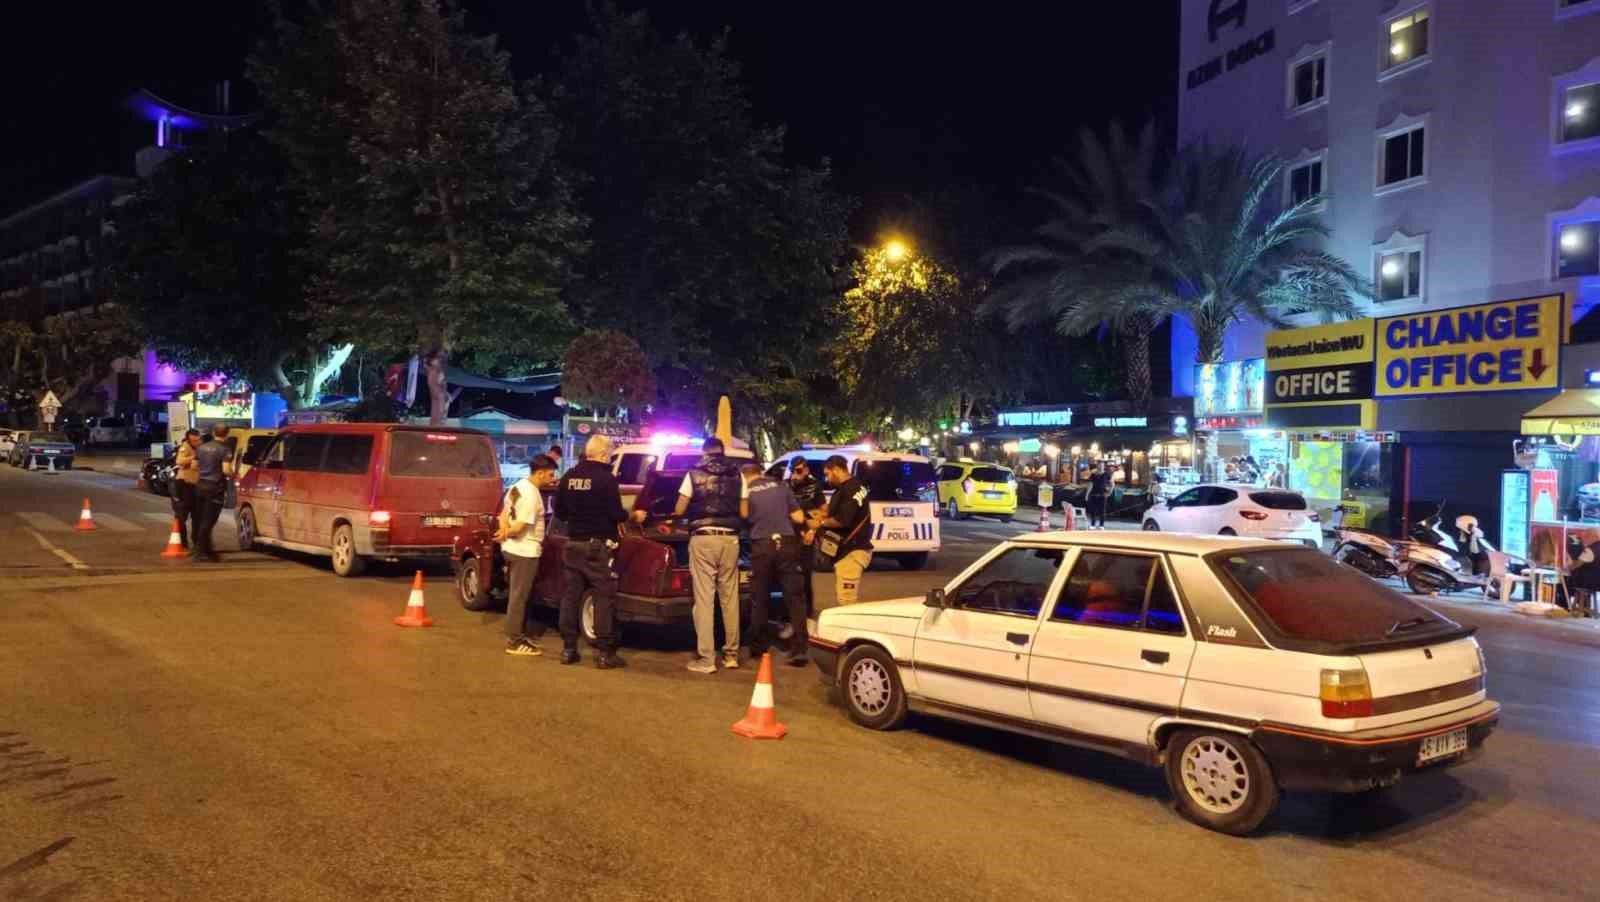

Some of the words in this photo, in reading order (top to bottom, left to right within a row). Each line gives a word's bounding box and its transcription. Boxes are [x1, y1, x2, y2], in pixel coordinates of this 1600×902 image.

[1386, 304, 1539, 350] CHANGE
[1275, 370, 1351, 397] OFFICE
[1385, 350, 1523, 389] OFFICE
